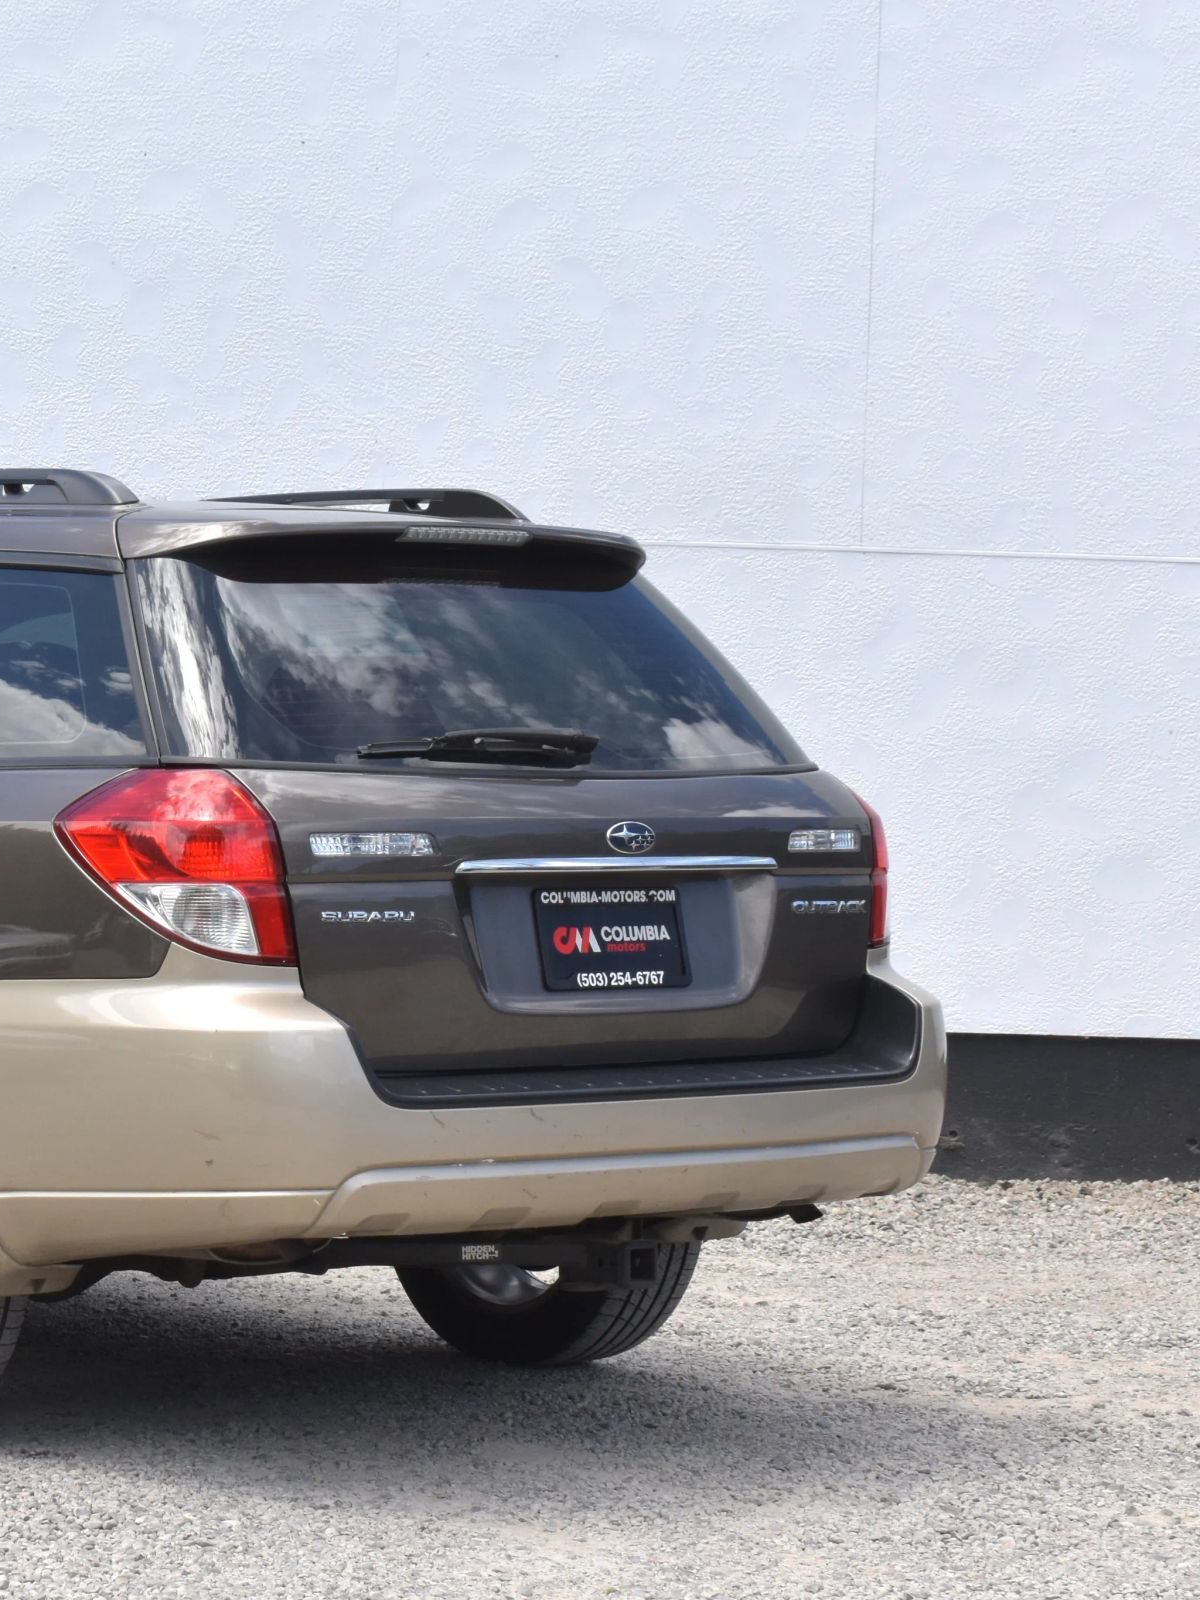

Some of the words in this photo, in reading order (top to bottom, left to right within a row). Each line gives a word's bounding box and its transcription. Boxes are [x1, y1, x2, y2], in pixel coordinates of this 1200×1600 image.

[792, 900, 867, 914] OUTBACK
[321, 910, 415, 922] SUBARU
[601, 925, 670, 941] COLUMBIA
[607, 941, 645, 952] motors
[577, 973, 608, 987] (503)
[611, 970, 664, 986] 254-6767
[461, 1244, 495, 1253] HIDDEN
[461, 1252, 489, 1260] HITCH
